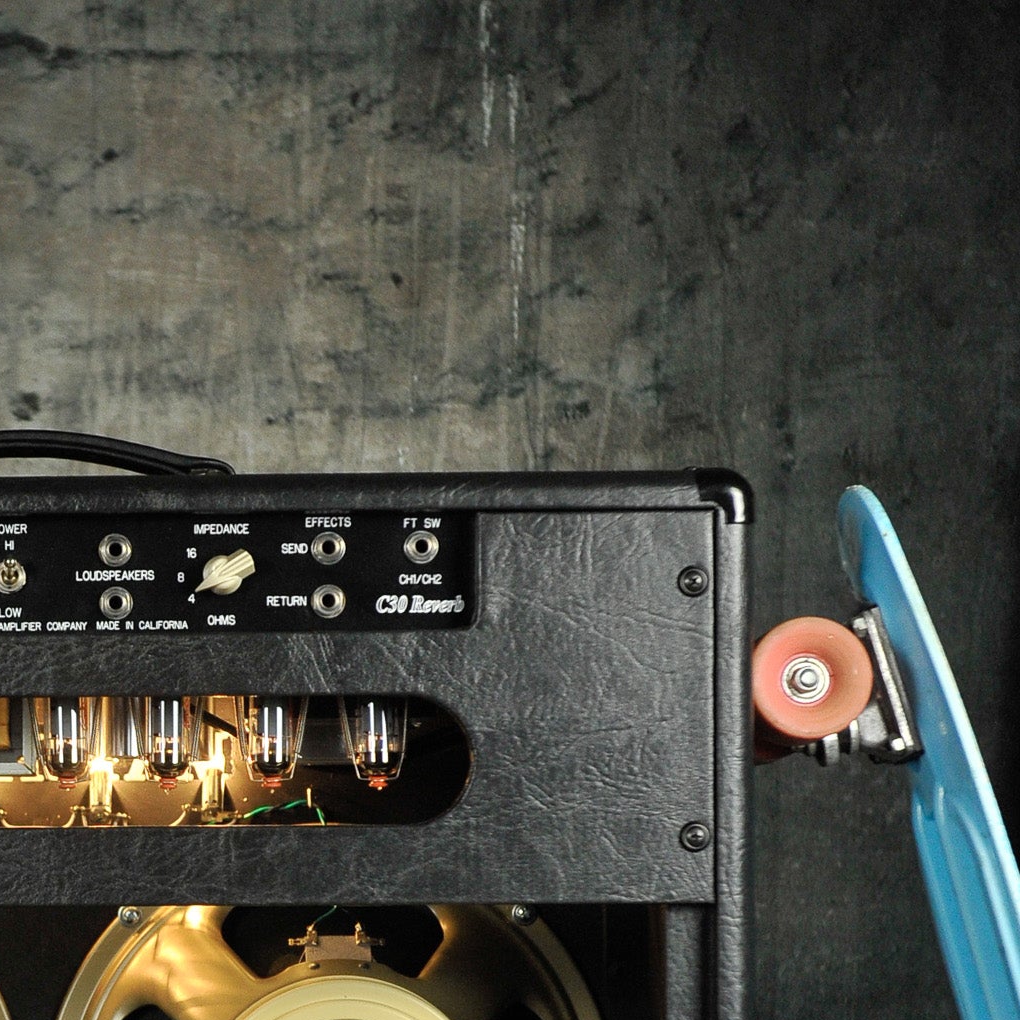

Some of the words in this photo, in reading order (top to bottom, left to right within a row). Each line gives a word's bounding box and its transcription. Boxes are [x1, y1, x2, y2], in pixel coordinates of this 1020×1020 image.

[305, 517, 351, 528] EFFECTS
[403, 518, 417, 528] FT
[424, 518, 441, 528] SW
[194, 524, 249, 534] IMPEDANCE
[4, 540, 15, 550] HI
[281, 543, 308, 554] SEND
[186, 548, 197, 559] 16
[75, 570, 155, 582] LOUDSPEAKERS
[177, 572, 185, 583] 8
[399, 574, 443, 585] CH1/CH2
[188, 594, 196, 604] 4
[266, 596, 307, 606] RETURN
[376, 595, 408, 614] C30
[409, 595, 465, 614] Reverb
[96, 621, 120, 630] MADE
[126, 621, 134, 630] IN
[139, 620, 188, 630] CALIFORNIA
[207, 615, 236, 626] OHMS
[47, 622, 87, 631] COMPANY
